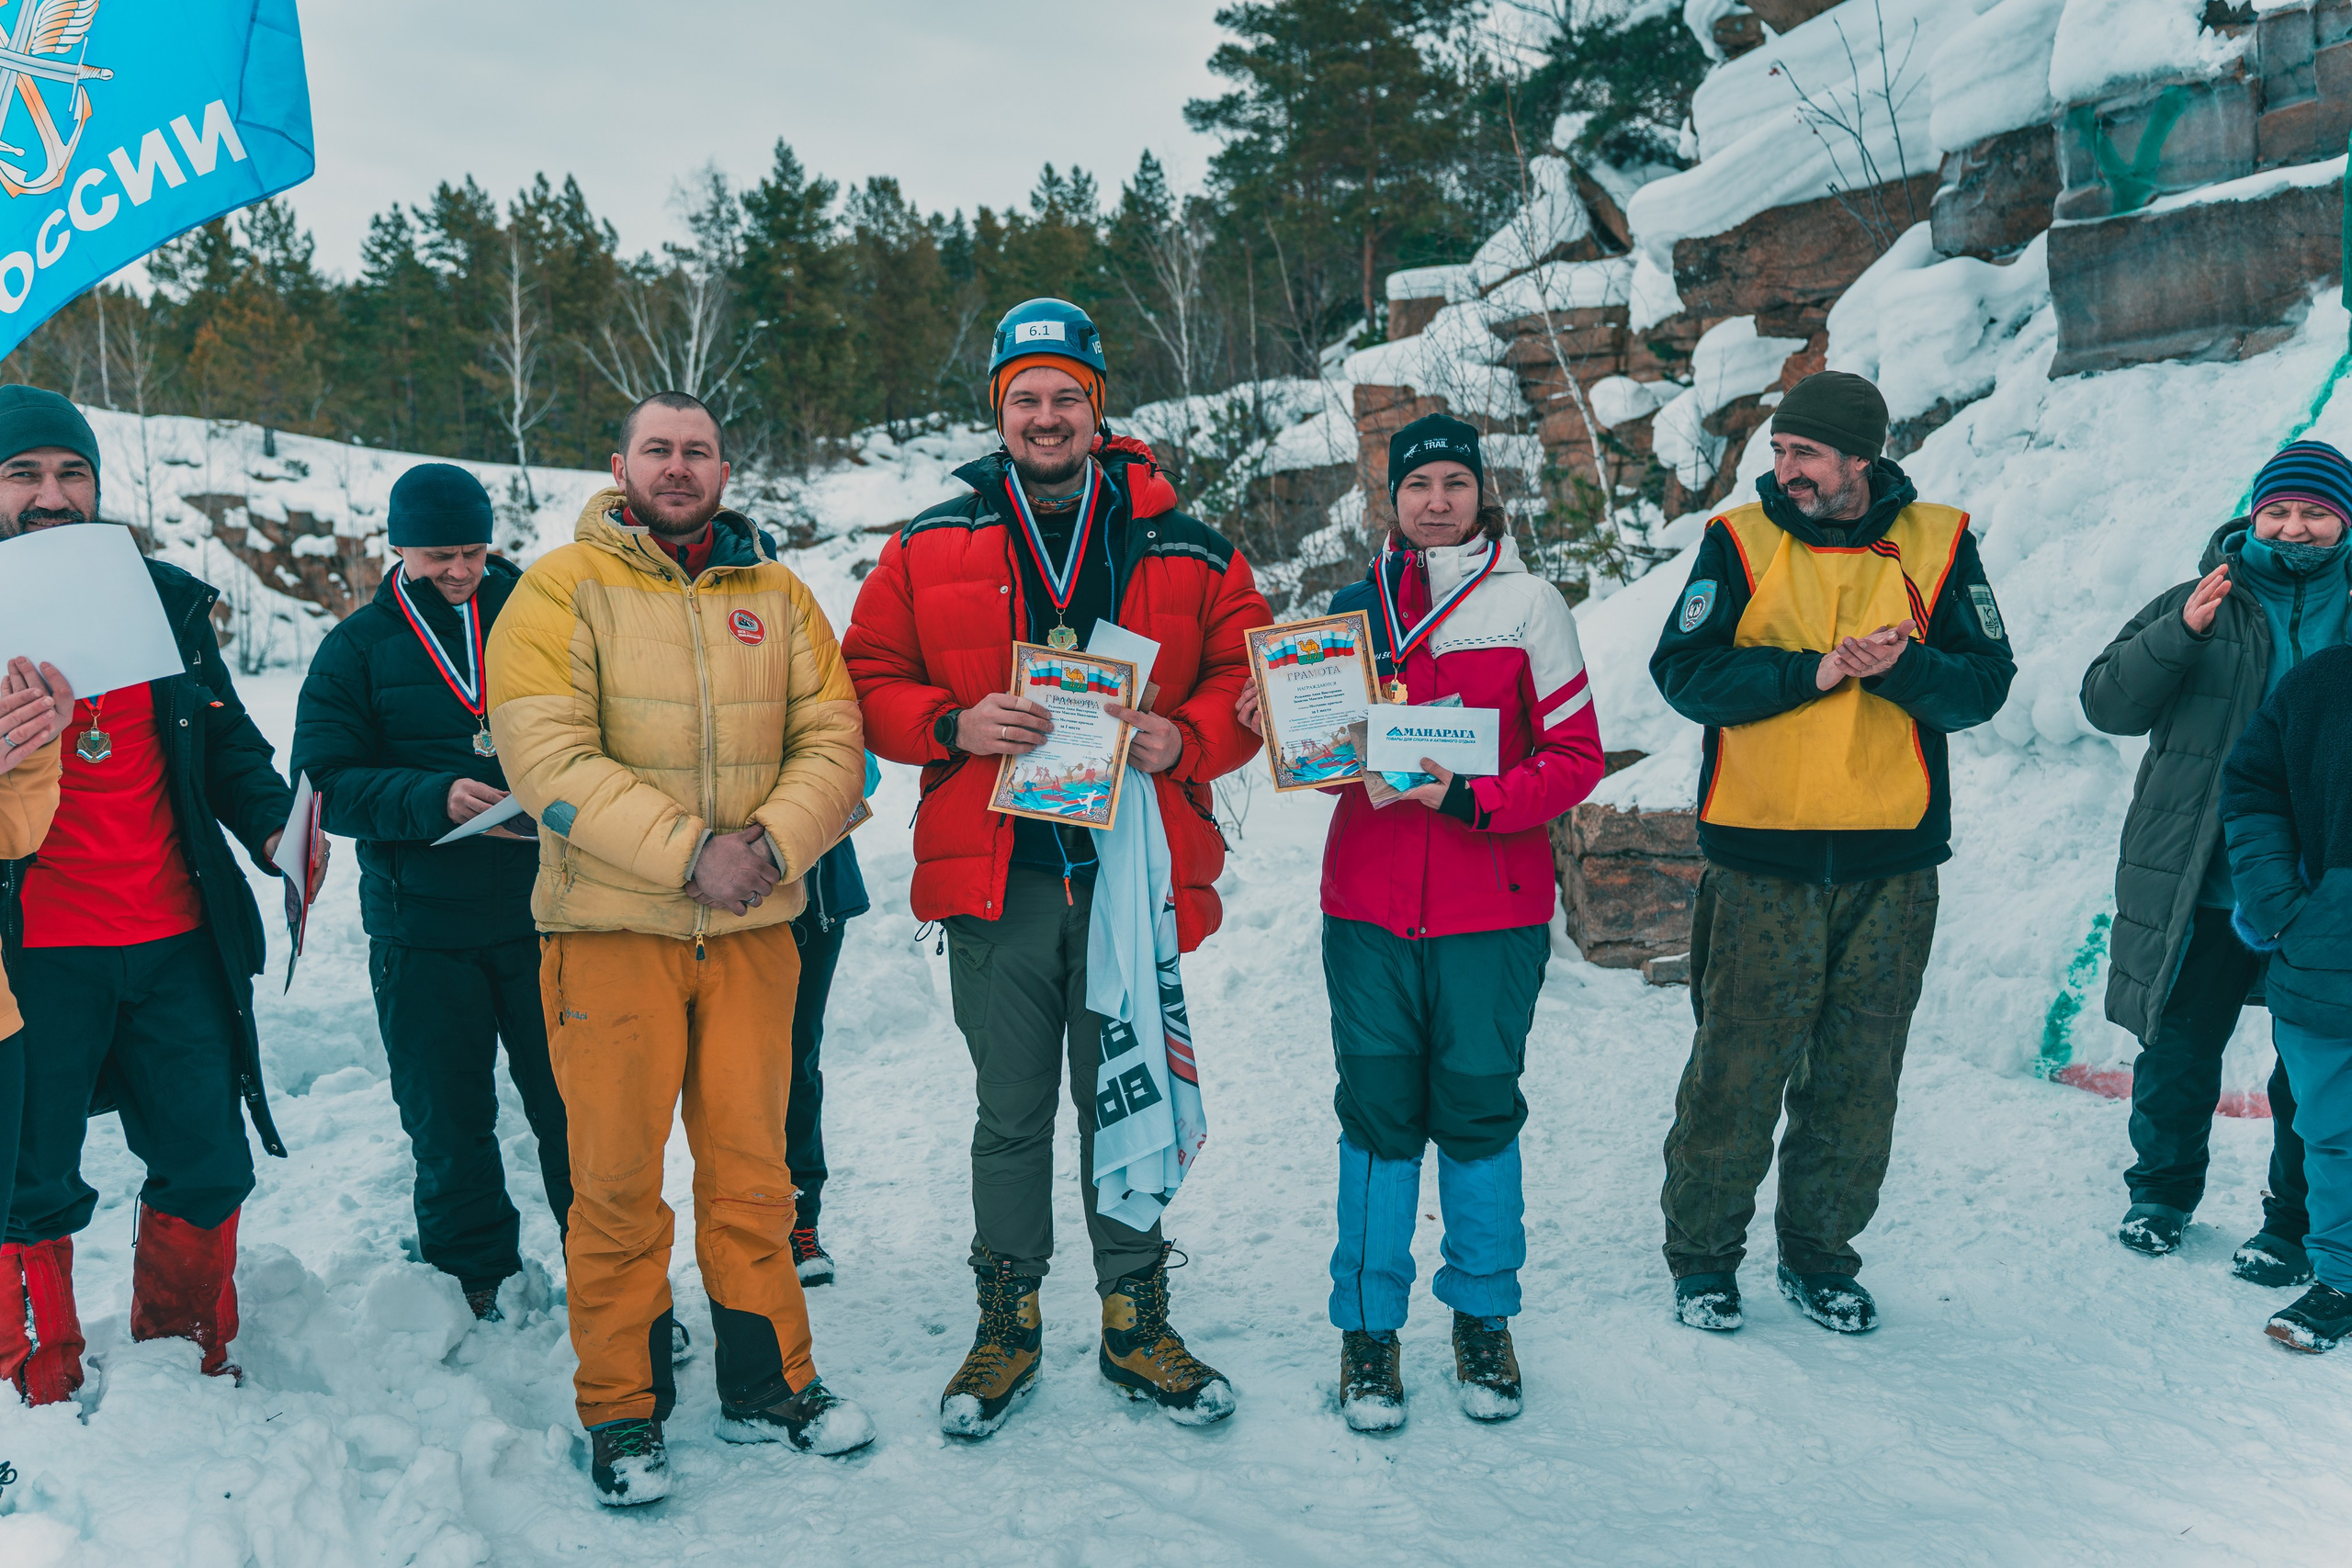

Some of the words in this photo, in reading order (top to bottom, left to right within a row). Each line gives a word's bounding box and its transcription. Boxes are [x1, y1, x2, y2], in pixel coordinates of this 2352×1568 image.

[1029, 325, 1050, 336] 6.1
[1287, 666, 1340, 682] ГРАМОТА
[1403, 728, 1476, 739] МАНАРАГА
